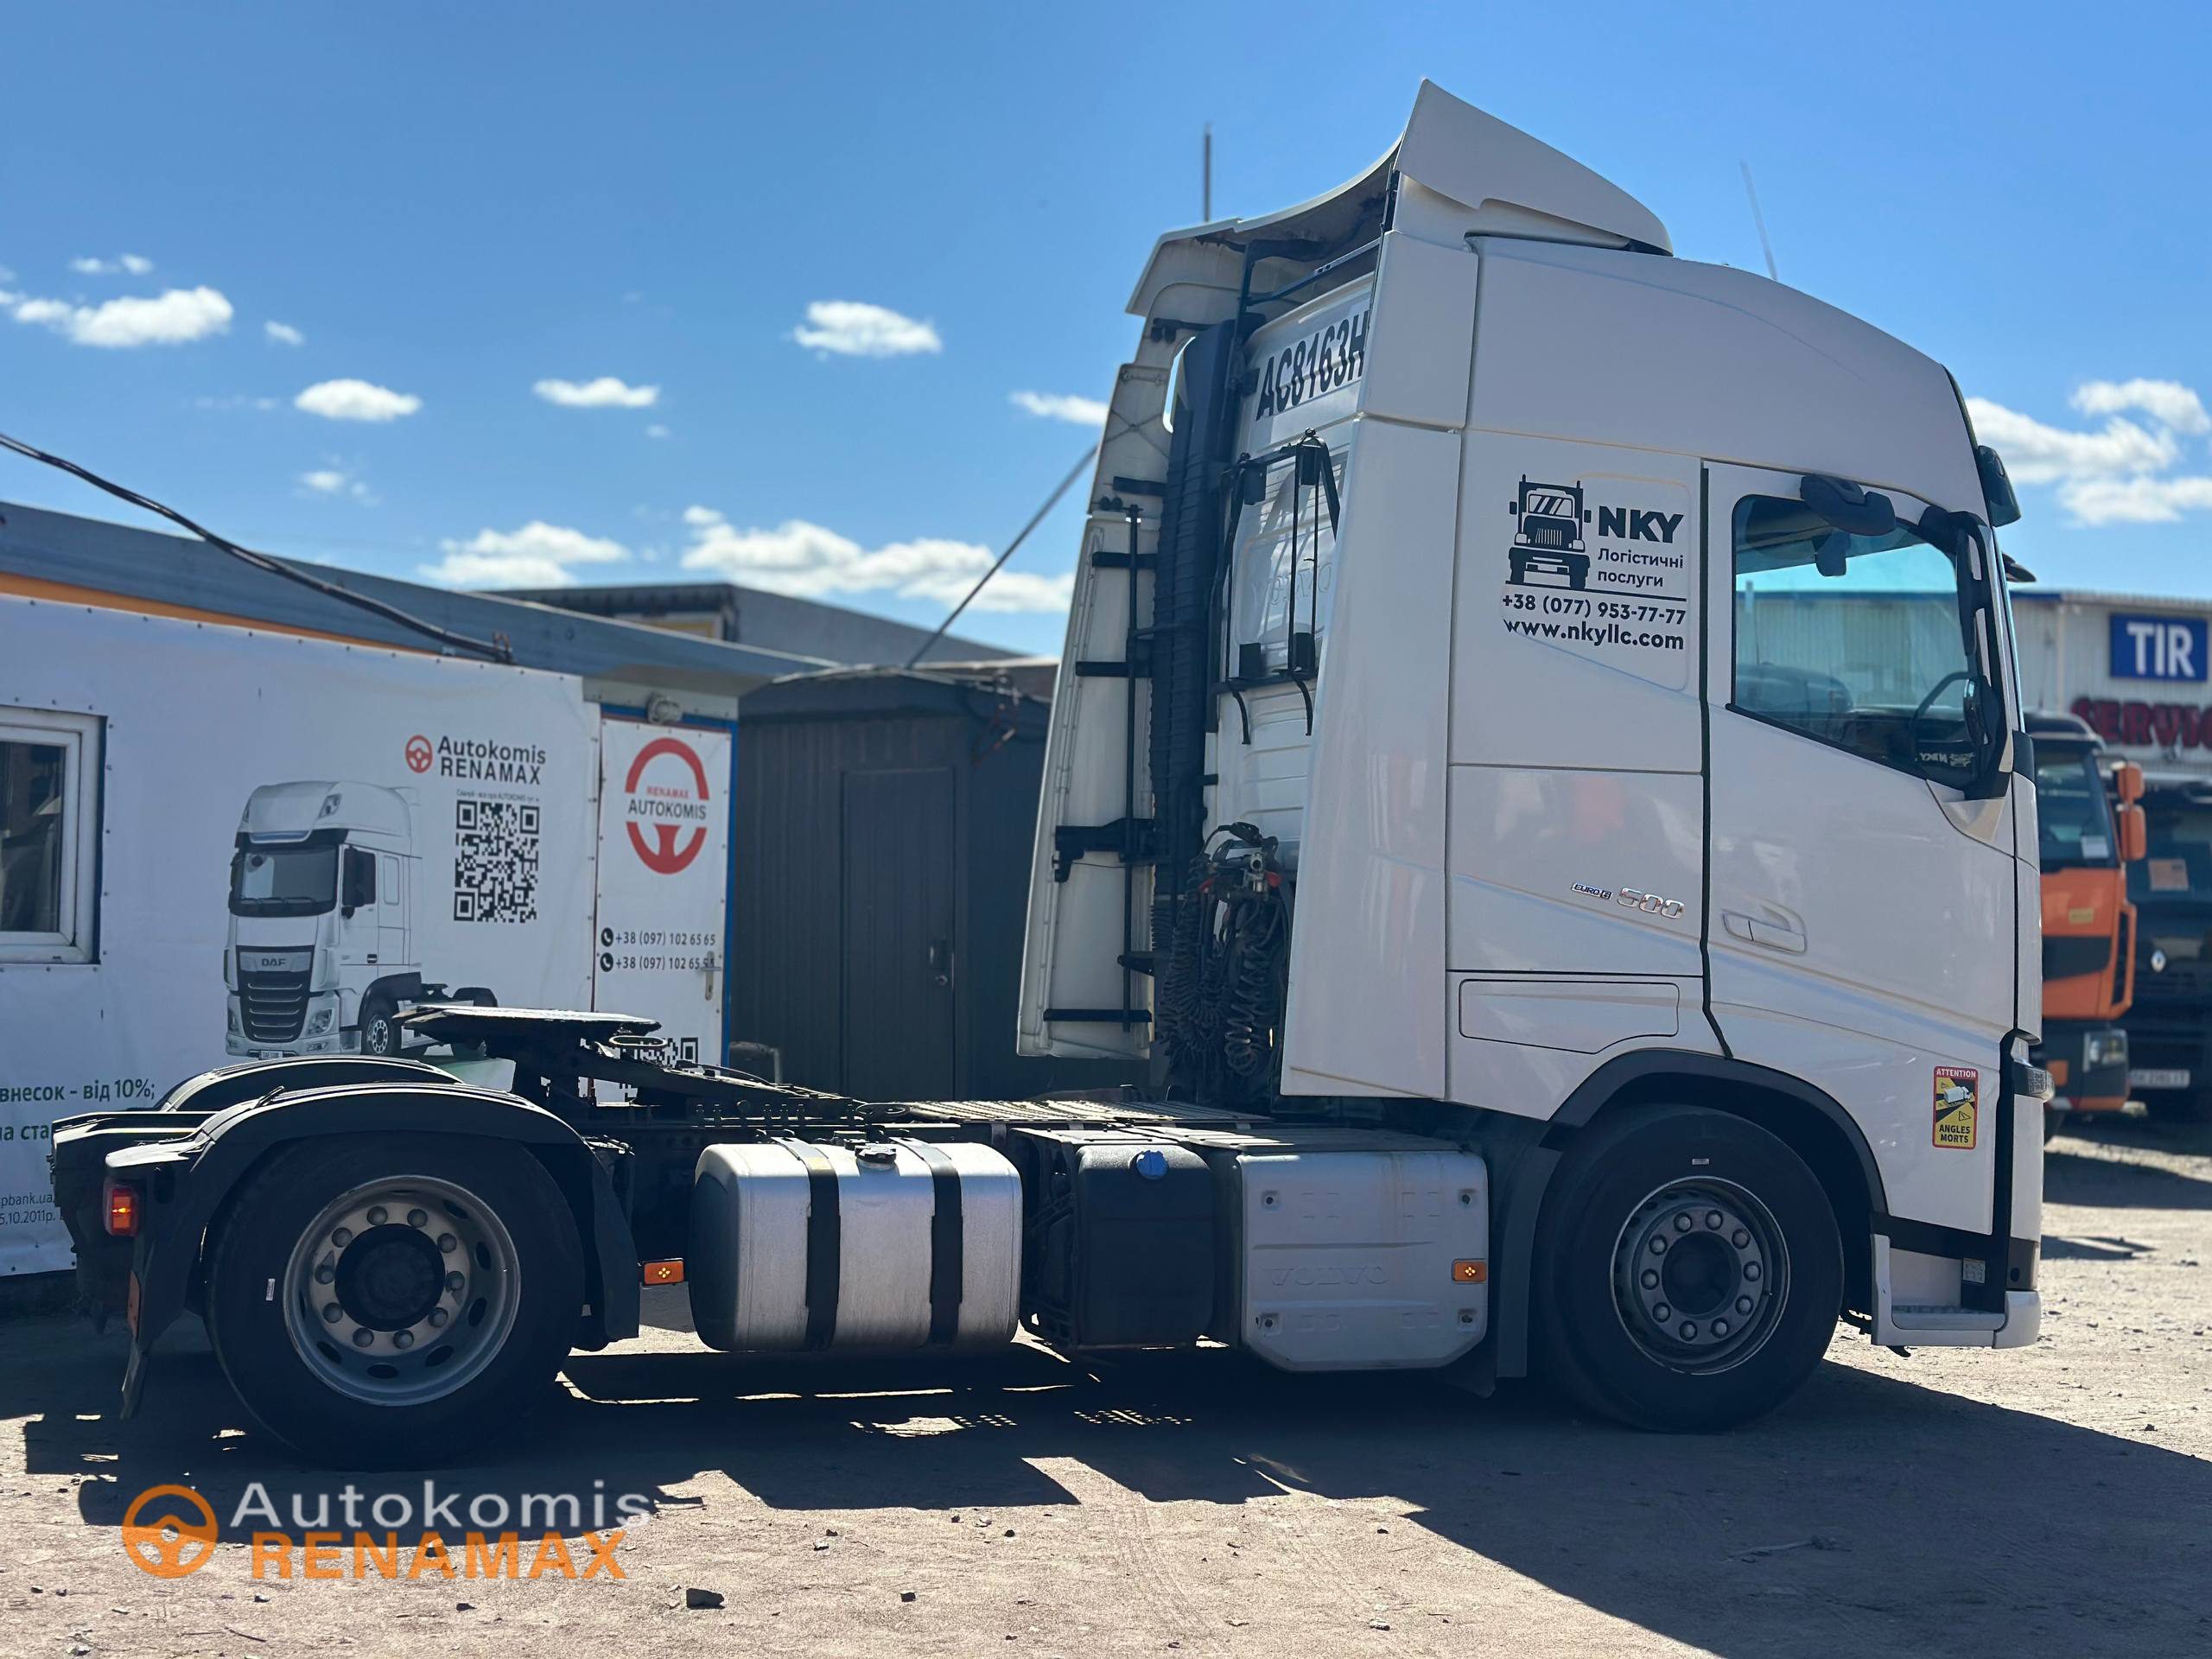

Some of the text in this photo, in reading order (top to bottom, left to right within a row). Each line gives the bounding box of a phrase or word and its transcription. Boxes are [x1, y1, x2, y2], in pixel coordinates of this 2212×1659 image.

[1599, 505, 1684, 543] NKY
[1598, 548, 1684, 569] Логістичні
[1598, 570, 1663, 588] послуги
[1503, 594, 1687, 625] +38 (077) 953-77-77
[1503, 619, 1684, 650] www.nkyllc.com
[2126, 621, 2196, 678] TIR
[437, 735, 546, 765] Autokomis
[441, 757, 541, 785] RENAMAX
[646, 785, 689, 799] RENAMAX
[628, 799, 707, 820] AUTOKOMIS
[1618, 887, 1685, 919] 500
[615, 931, 637, 944] +38
[639, 931, 665, 946] (097)
[670, 933, 688, 945] 102
[261, 958, 287, 967] DAF
[615, 957, 636, 969] +38
[639, 956, 664, 970] (097)
[669, 957, 686, 969] 102
[689, 957, 701, 969] 65
[1936, 1068, 1976, 1078] ATTENTION
[0, 1085, 65, 1102] внесок
[83, 1080, 110, 1102] від
[114, 1078, 155, 1100] 10%;
[0, 1127, 15, 1141] а
[1939, 1124, 1970, 1135] ANGLES
[1941, 1134, 1969, 1144] MORTS
[1262, 1266, 1389, 1286] VOLVO
